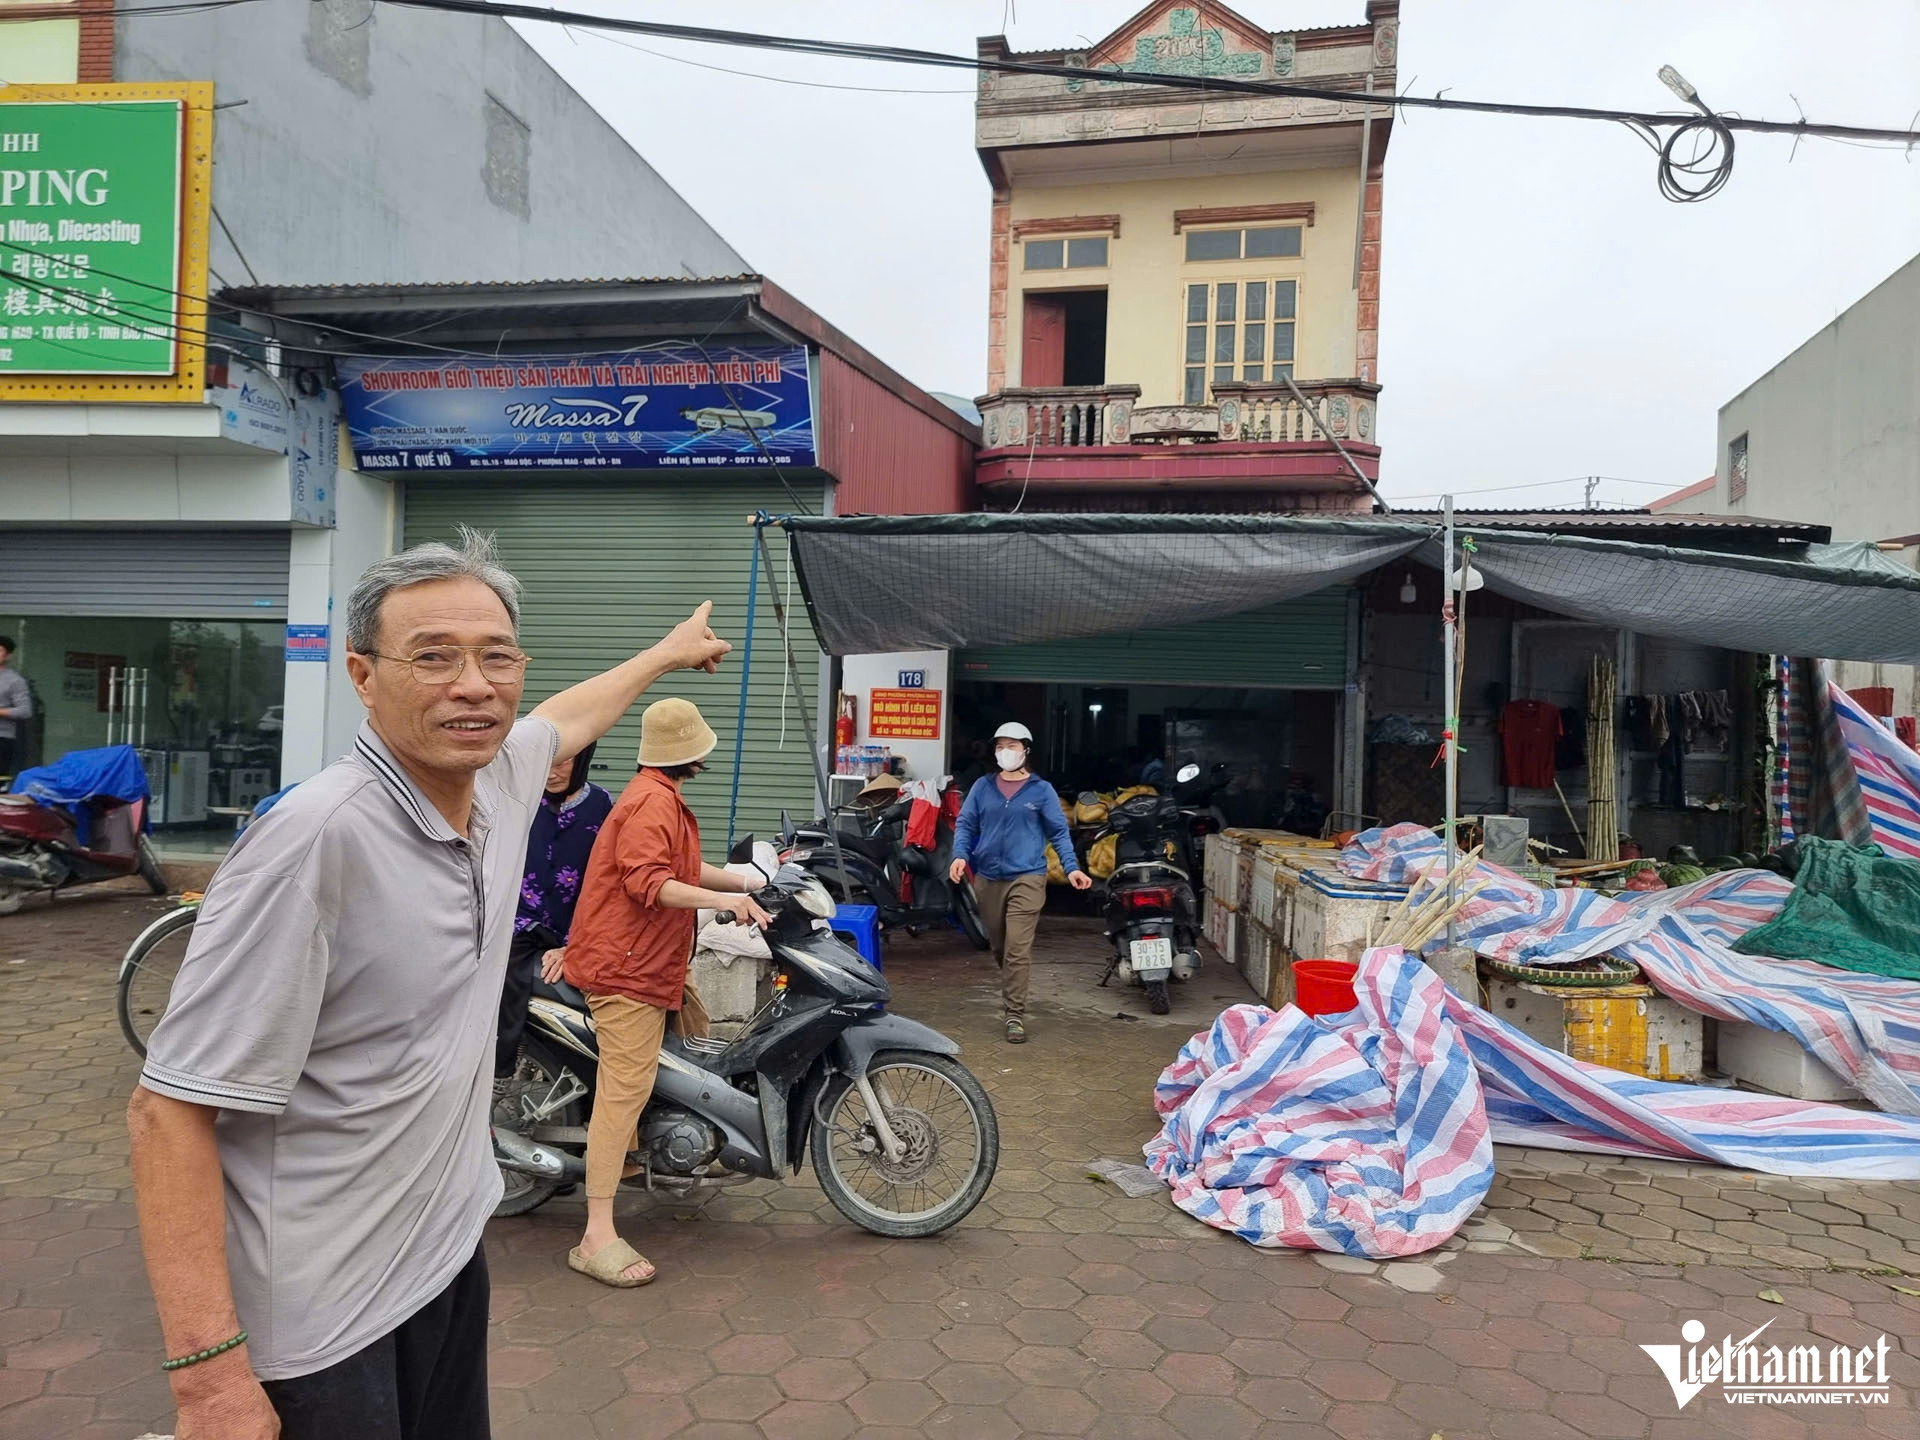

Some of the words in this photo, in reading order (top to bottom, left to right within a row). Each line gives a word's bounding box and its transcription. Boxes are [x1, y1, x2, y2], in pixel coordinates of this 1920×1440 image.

[0, 169, 109, 206] PING
[58, 219, 141, 245] Diecasting
[361, 369, 442, 391] SHOWROOM
[444, 364, 472, 389] GIỚI
[474, 364, 514, 392] THIỆU
[518, 360, 547, 388] SẢN
[549, 357, 592, 387] PHẨM
[594, 362, 615, 387] VÀ
[615, 359, 650, 386] TRẢI
[651, 360, 710, 388] NGHIỆM
[713, 355, 752, 384] MIỄN
[754, 357, 781, 384] PHÍ
[505, 398, 622, 427] Massa
[621, 395, 648, 426] 7
[362, 455, 399, 467] MASSA
[400, 451, 408, 467] 7
[415, 451, 436, 467] QUẾ
[437, 452, 451, 467] VÕ
[900, 672, 921, 686] 178
[1137, 954, 1166, 968] 7826
